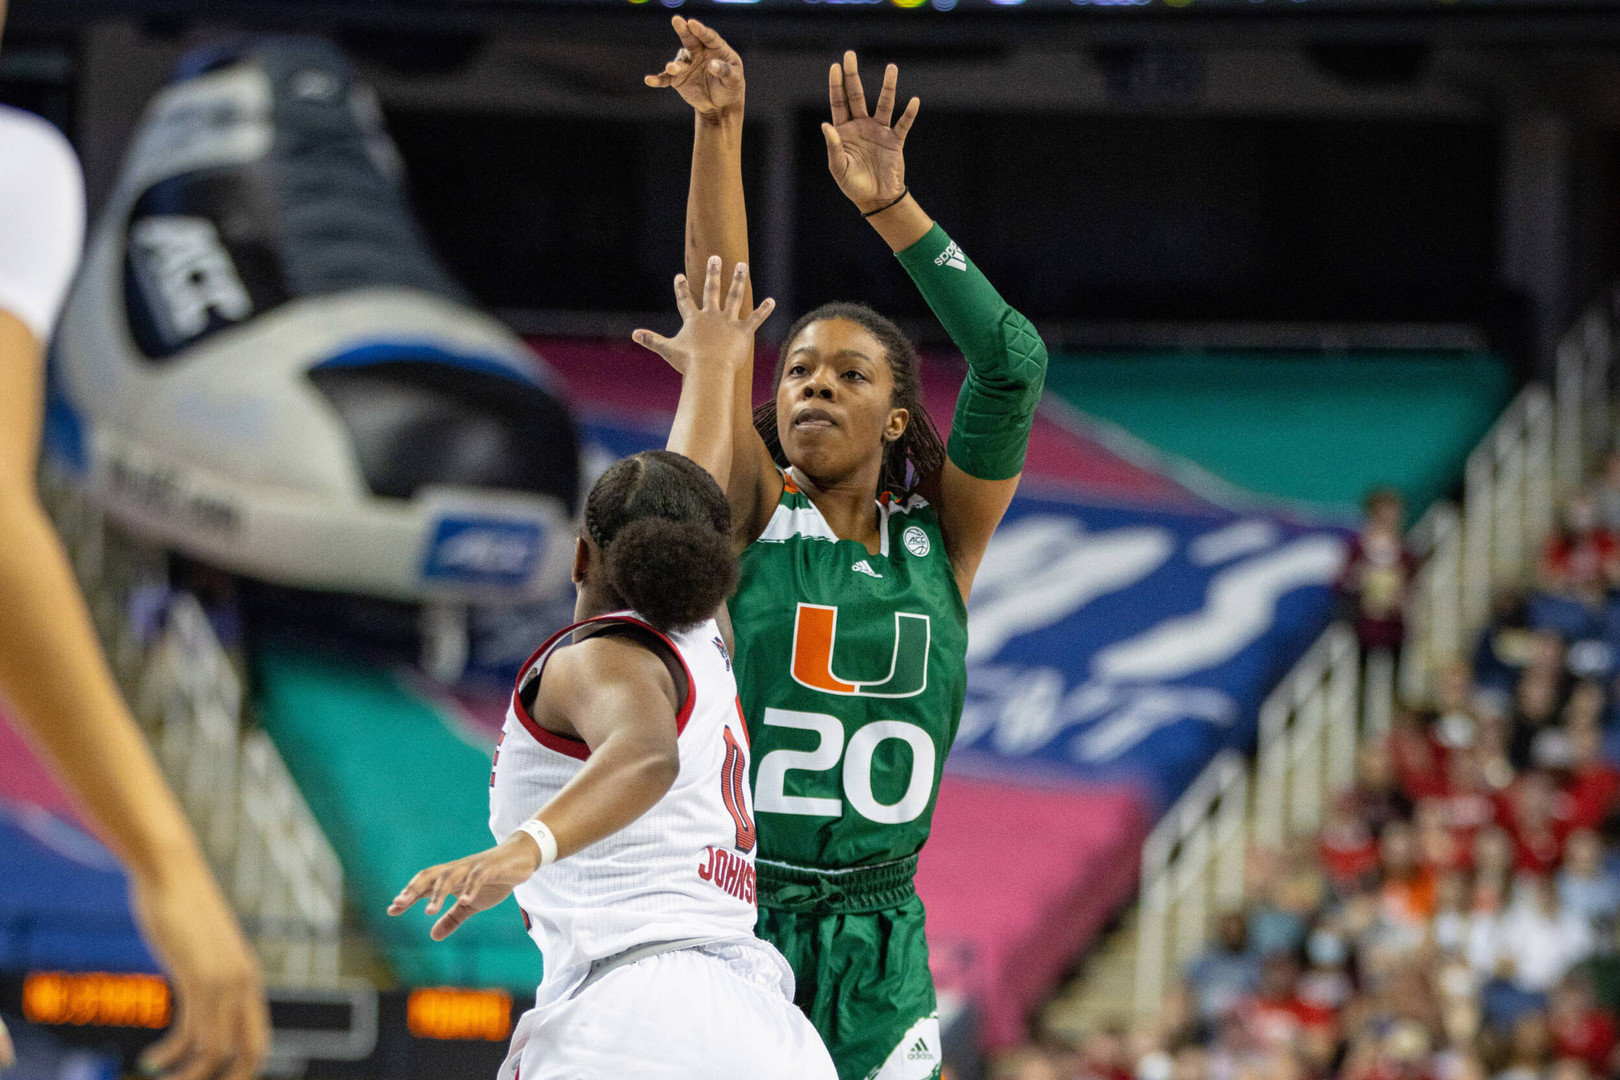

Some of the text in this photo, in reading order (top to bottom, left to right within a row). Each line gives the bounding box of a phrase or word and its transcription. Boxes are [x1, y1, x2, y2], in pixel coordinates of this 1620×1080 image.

[907, 536, 927, 546] ACC
[790, 602, 930, 698] U
[721, 725, 756, 855] 0
[754, 707, 935, 824] 20
[907, 1051, 934, 1061] adidas
